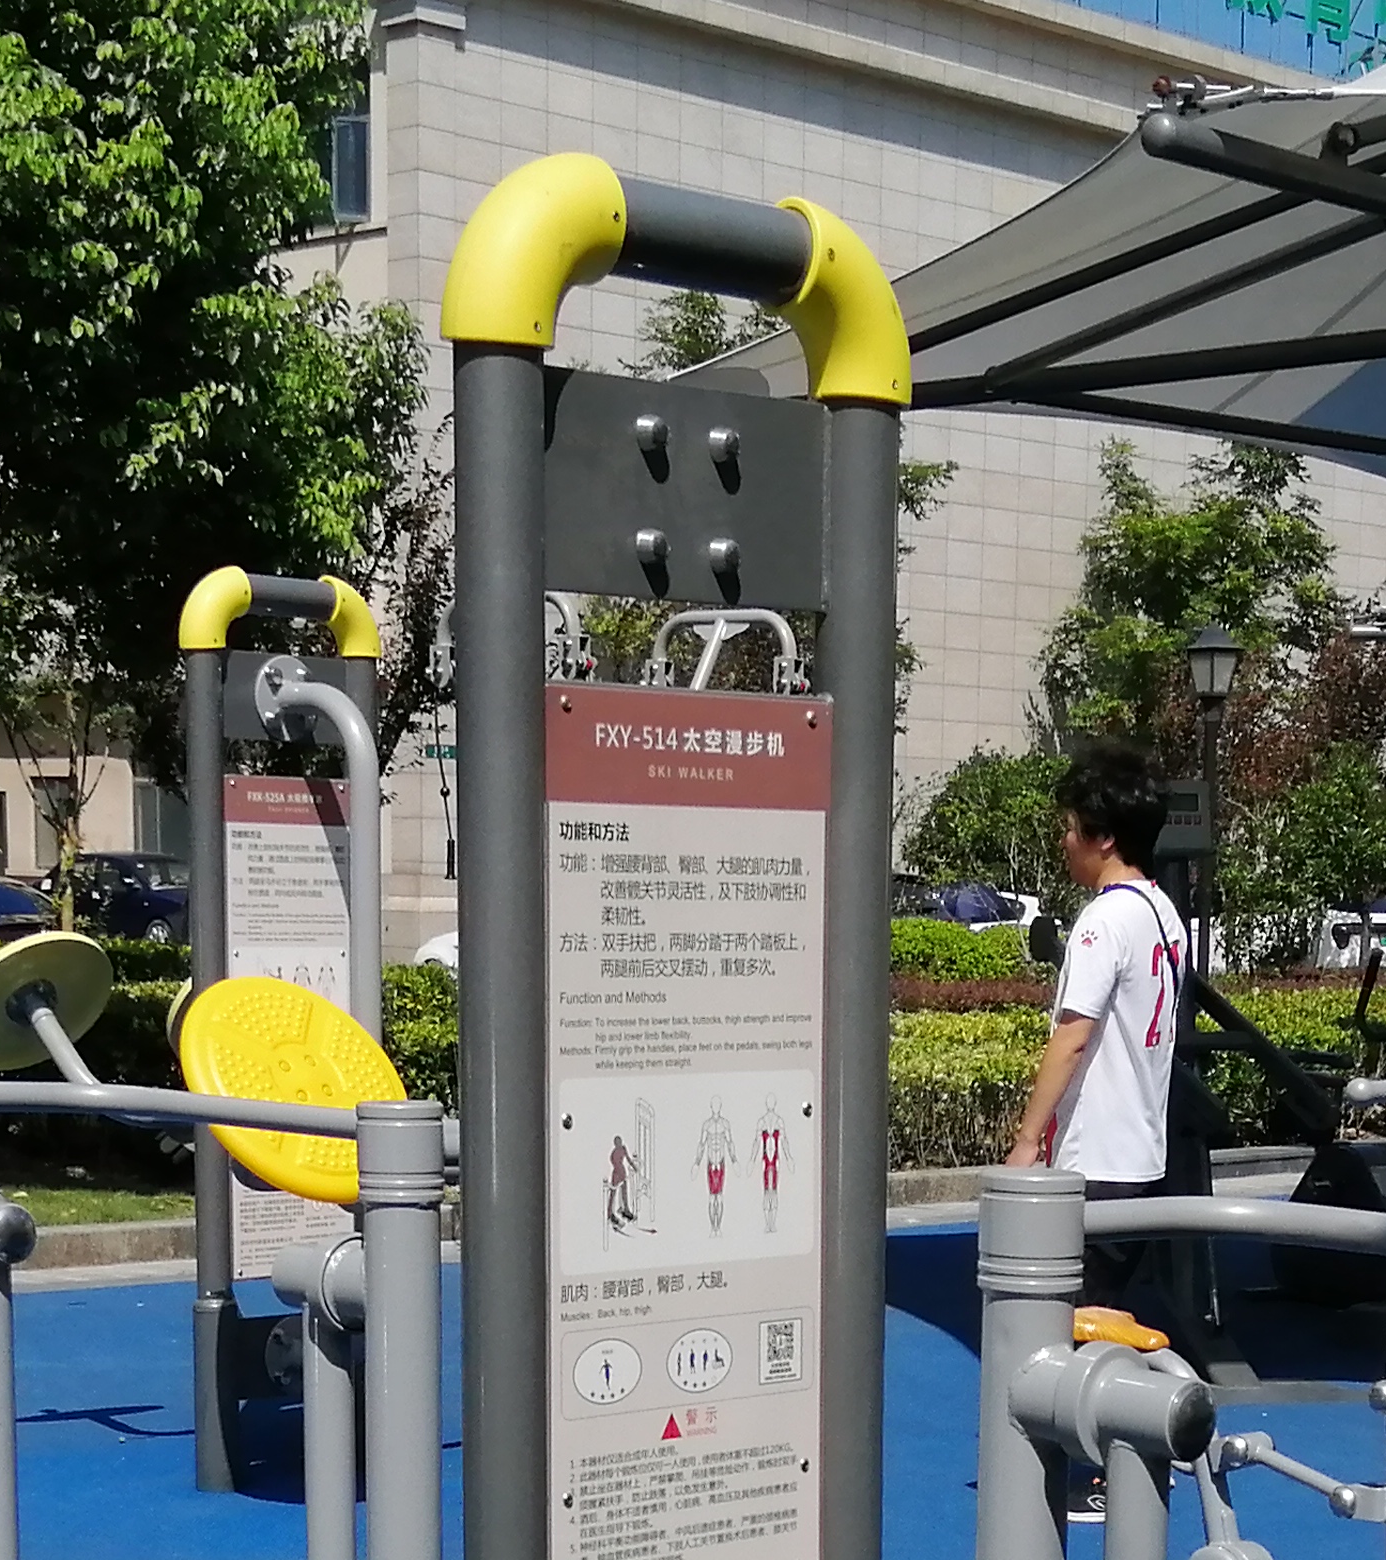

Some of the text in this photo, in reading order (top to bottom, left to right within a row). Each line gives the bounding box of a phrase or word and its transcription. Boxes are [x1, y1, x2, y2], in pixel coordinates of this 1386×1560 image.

[594, 722, 785, 758] FXY-514 太空漫步机
[648, 764, 732, 780] SKI WALKER
[558, 820, 630, 843] 功能和方法
[559, 989, 667, 1005] Function and Methods
